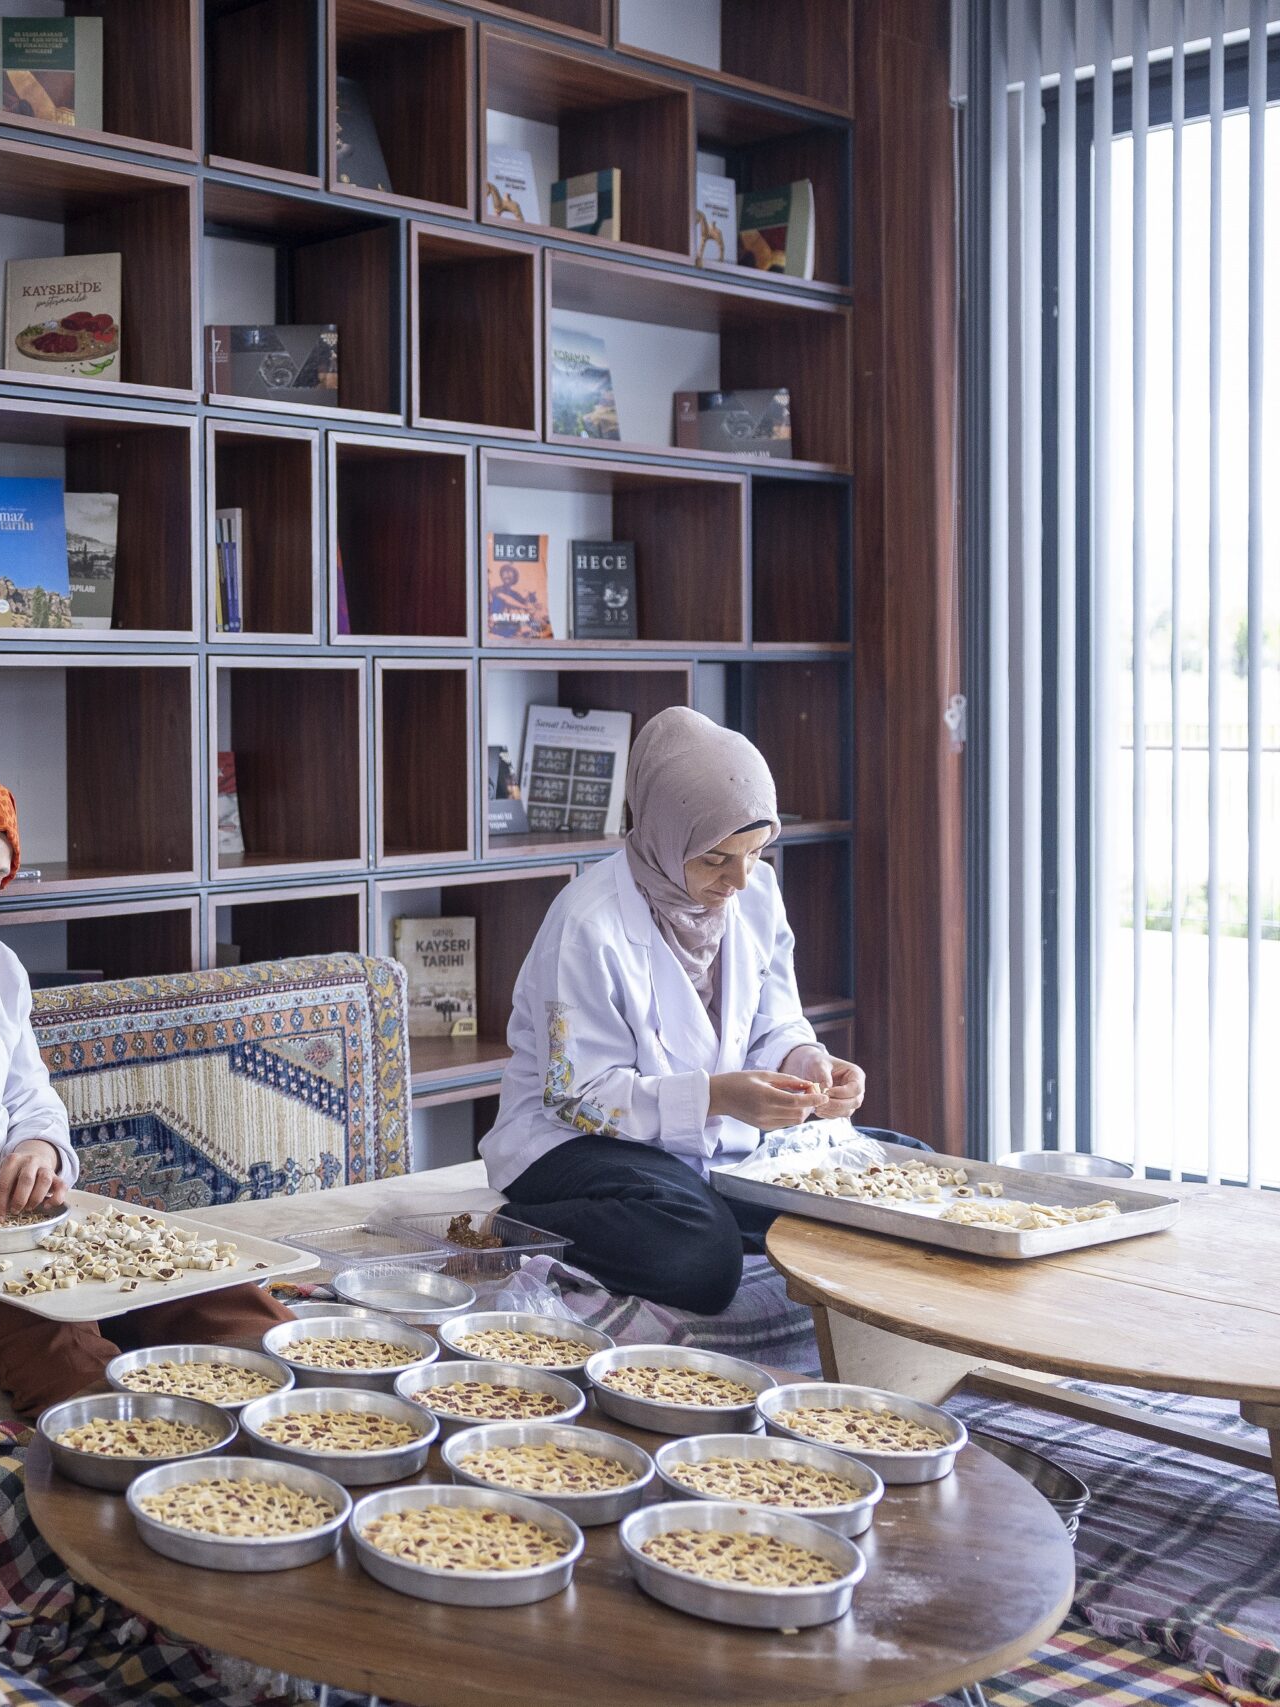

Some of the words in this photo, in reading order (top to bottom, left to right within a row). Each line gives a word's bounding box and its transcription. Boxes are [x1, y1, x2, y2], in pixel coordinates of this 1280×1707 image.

[495, 543, 538, 559] HECE
[577, 555, 628, 570] HECE
[415, 938, 471, 953] KAYSERİ
[422, 954, 465, 968] TARİHİ
